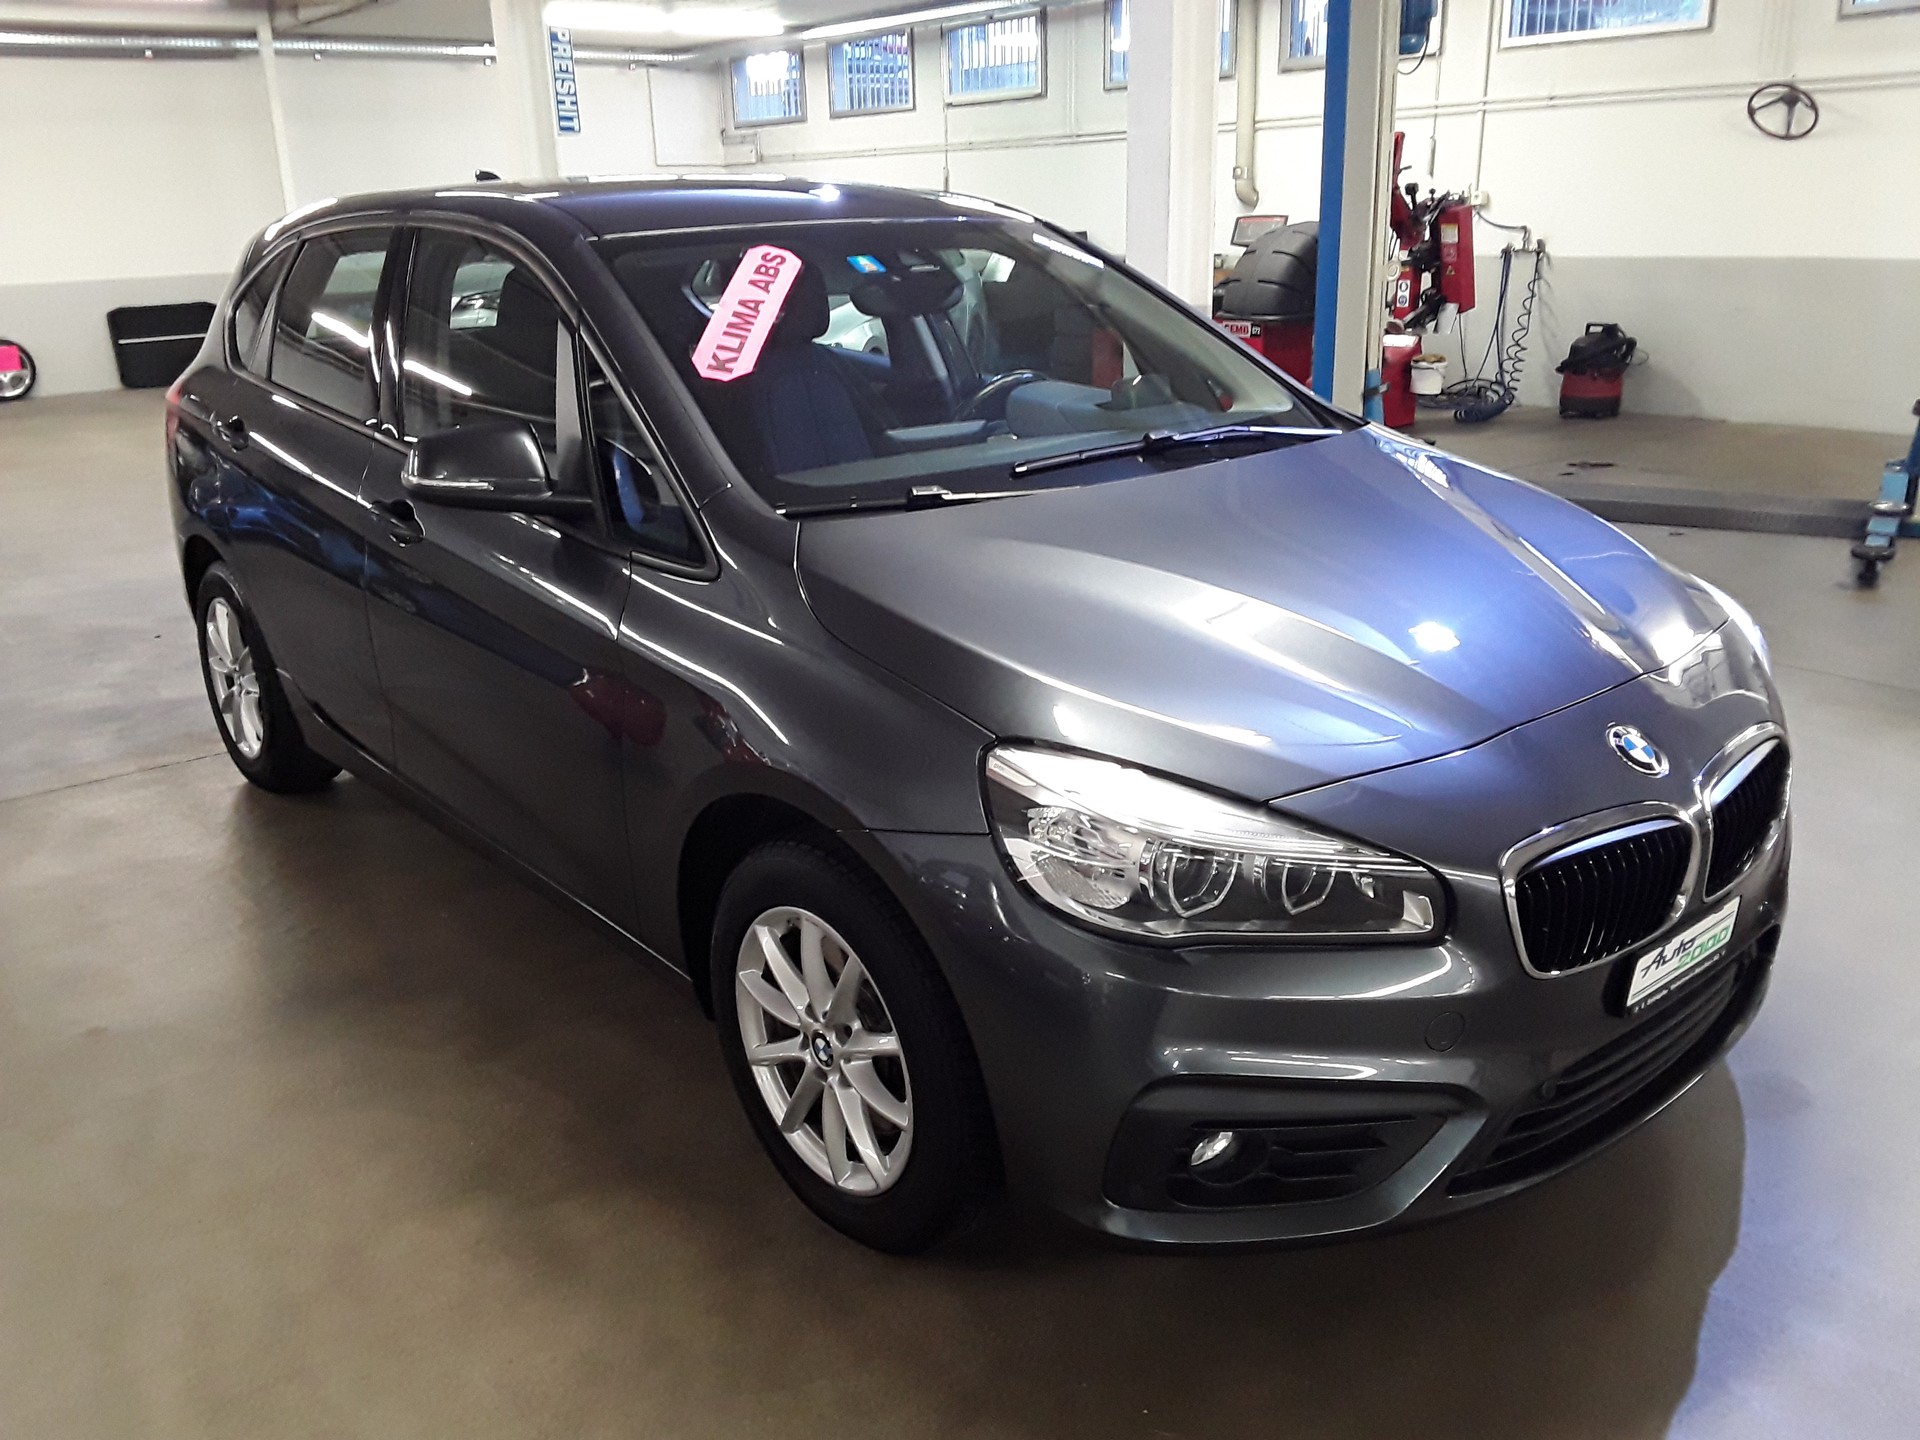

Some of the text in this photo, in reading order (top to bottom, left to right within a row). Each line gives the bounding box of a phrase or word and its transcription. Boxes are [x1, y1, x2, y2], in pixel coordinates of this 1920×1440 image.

[550, 27, 580, 132] PREISHIT
[706, 252, 787, 375] KLIMA ABS
